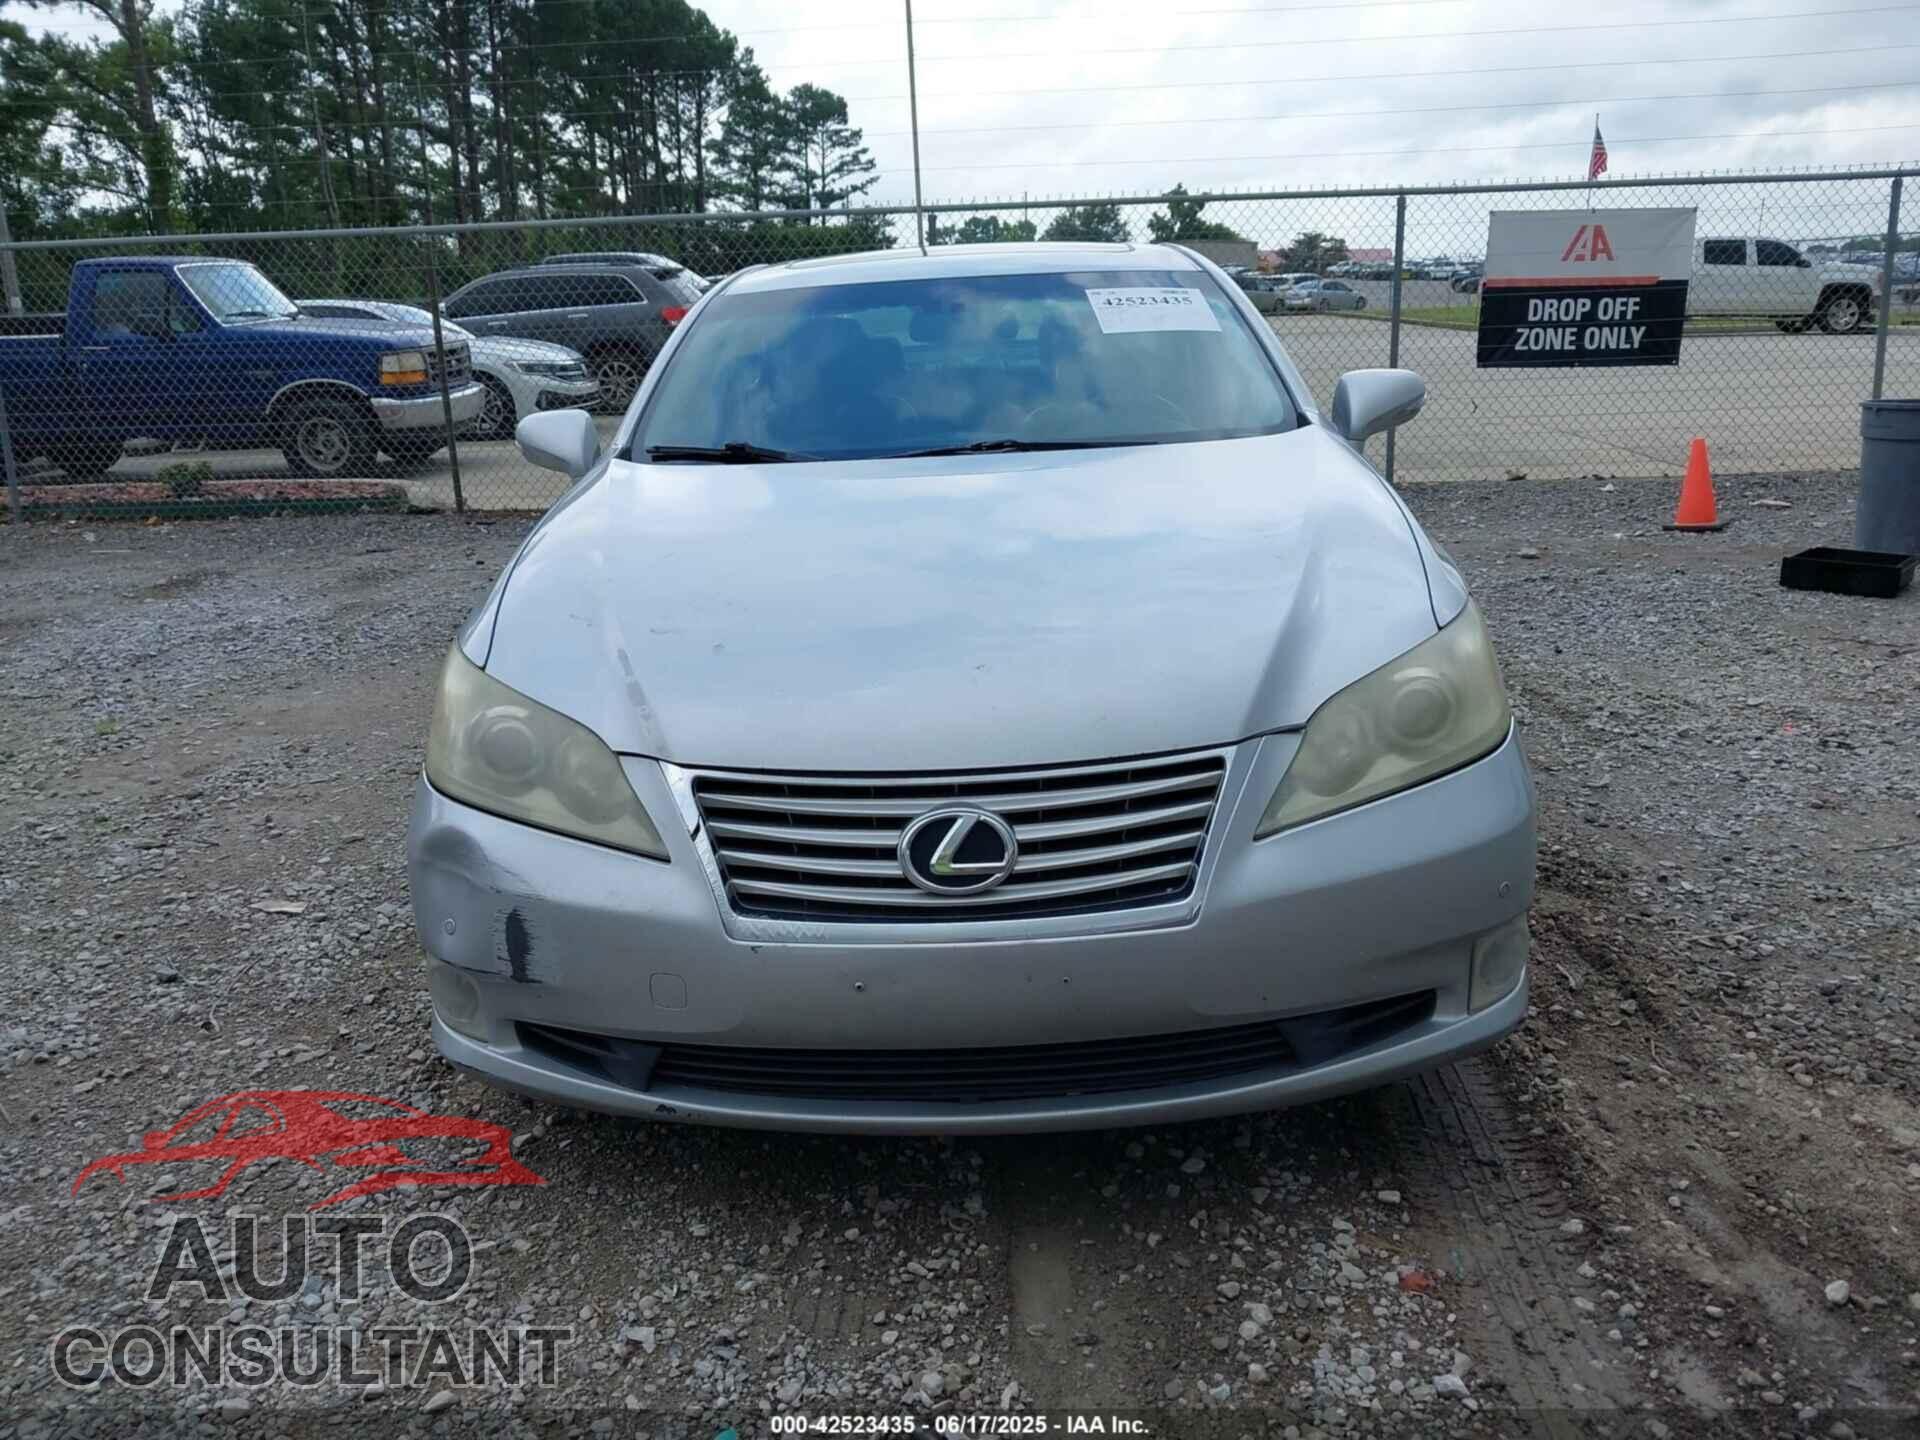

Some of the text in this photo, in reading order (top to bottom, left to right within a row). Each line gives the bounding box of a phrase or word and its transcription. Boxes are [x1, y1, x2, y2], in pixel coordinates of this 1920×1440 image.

[1103, 296, 1193, 306] 42523435
[1528, 297, 1641, 322] DROP OFF
[1514, 326, 1647, 350] ZONE ONLY
